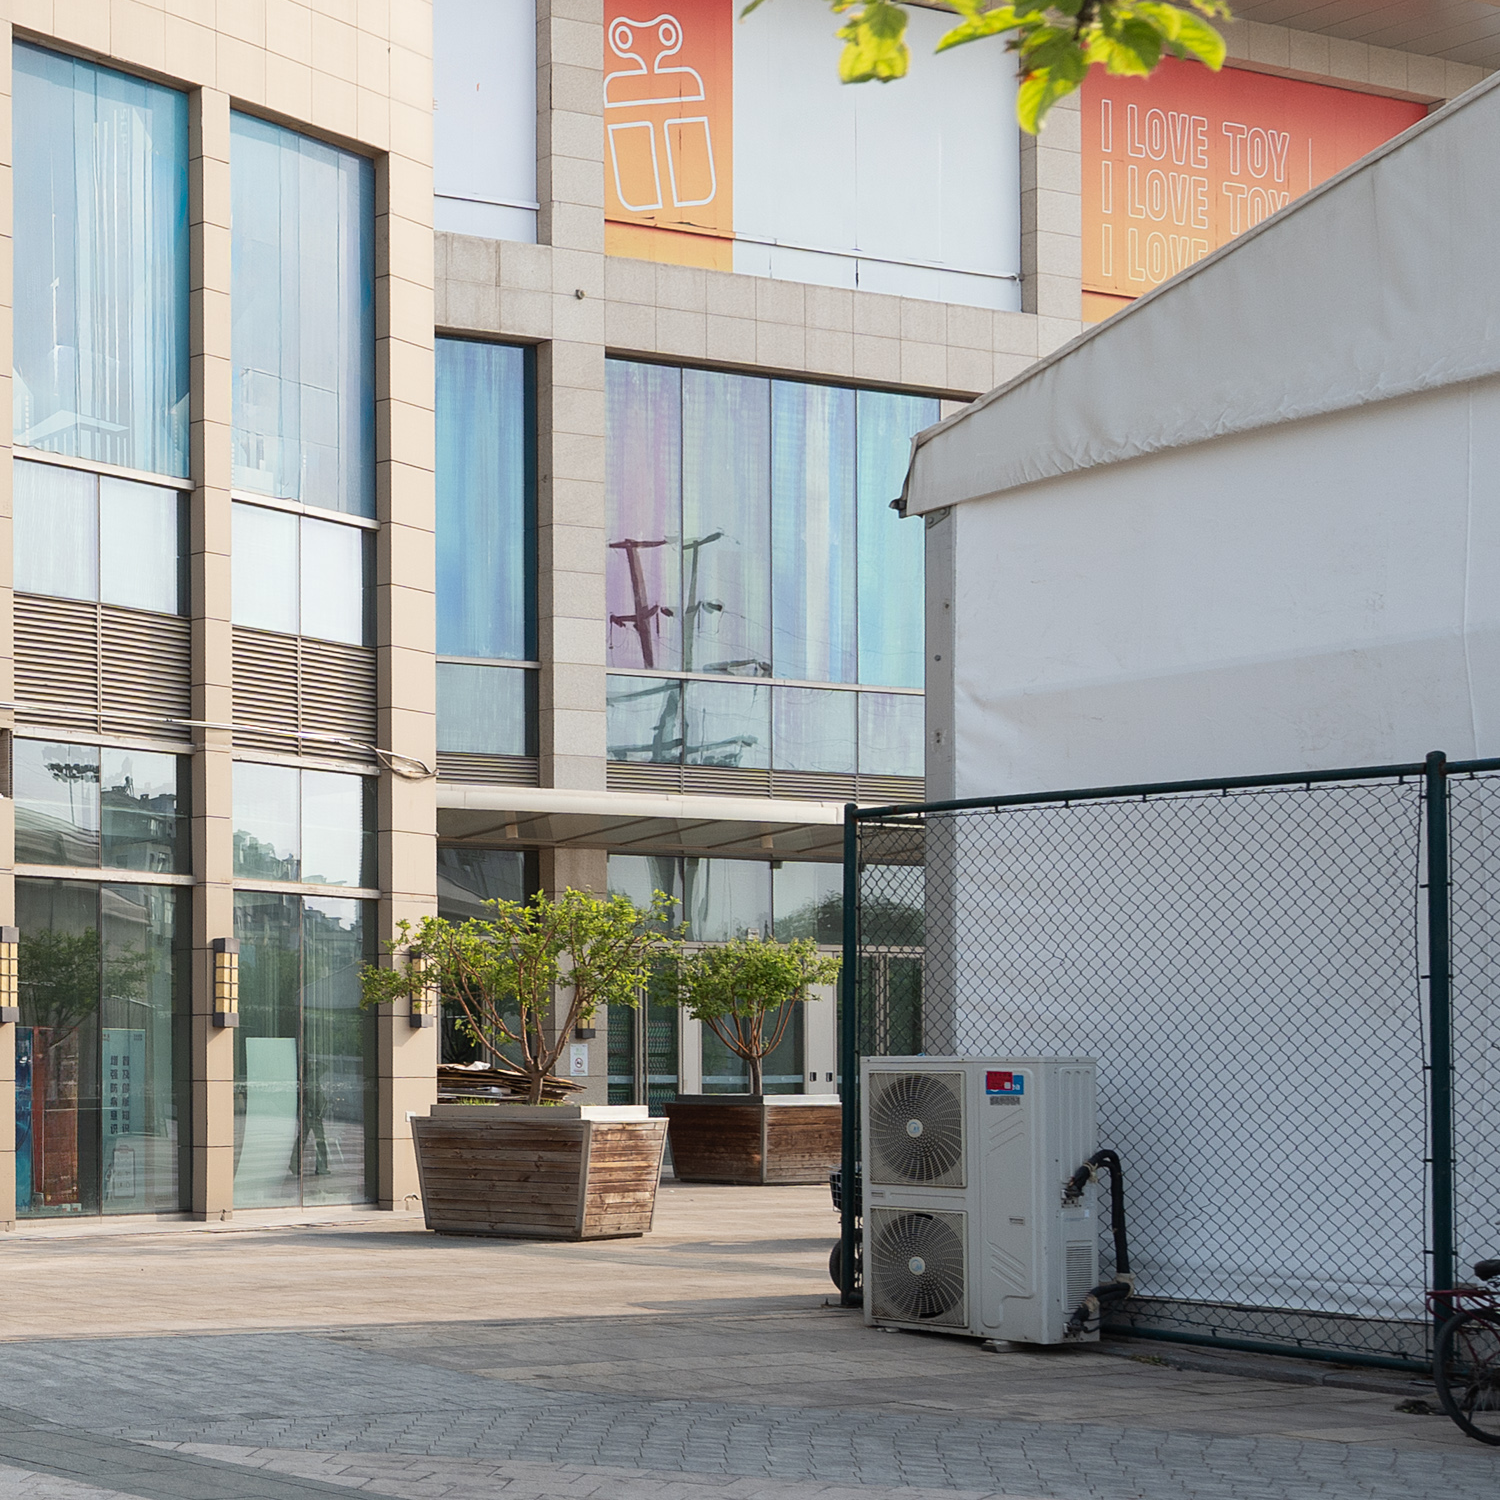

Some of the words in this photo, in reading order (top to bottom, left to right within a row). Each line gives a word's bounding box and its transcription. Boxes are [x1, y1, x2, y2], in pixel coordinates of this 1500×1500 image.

[1102, 99, 1112, 152] I
[1127, 104, 1208, 169] LOVE
[1222, 122, 1290, 182] TOY
[1102, 160, 1112, 214] I
[1128, 165, 1208, 229] LOVE
[1102, 224, 1112, 277] I
